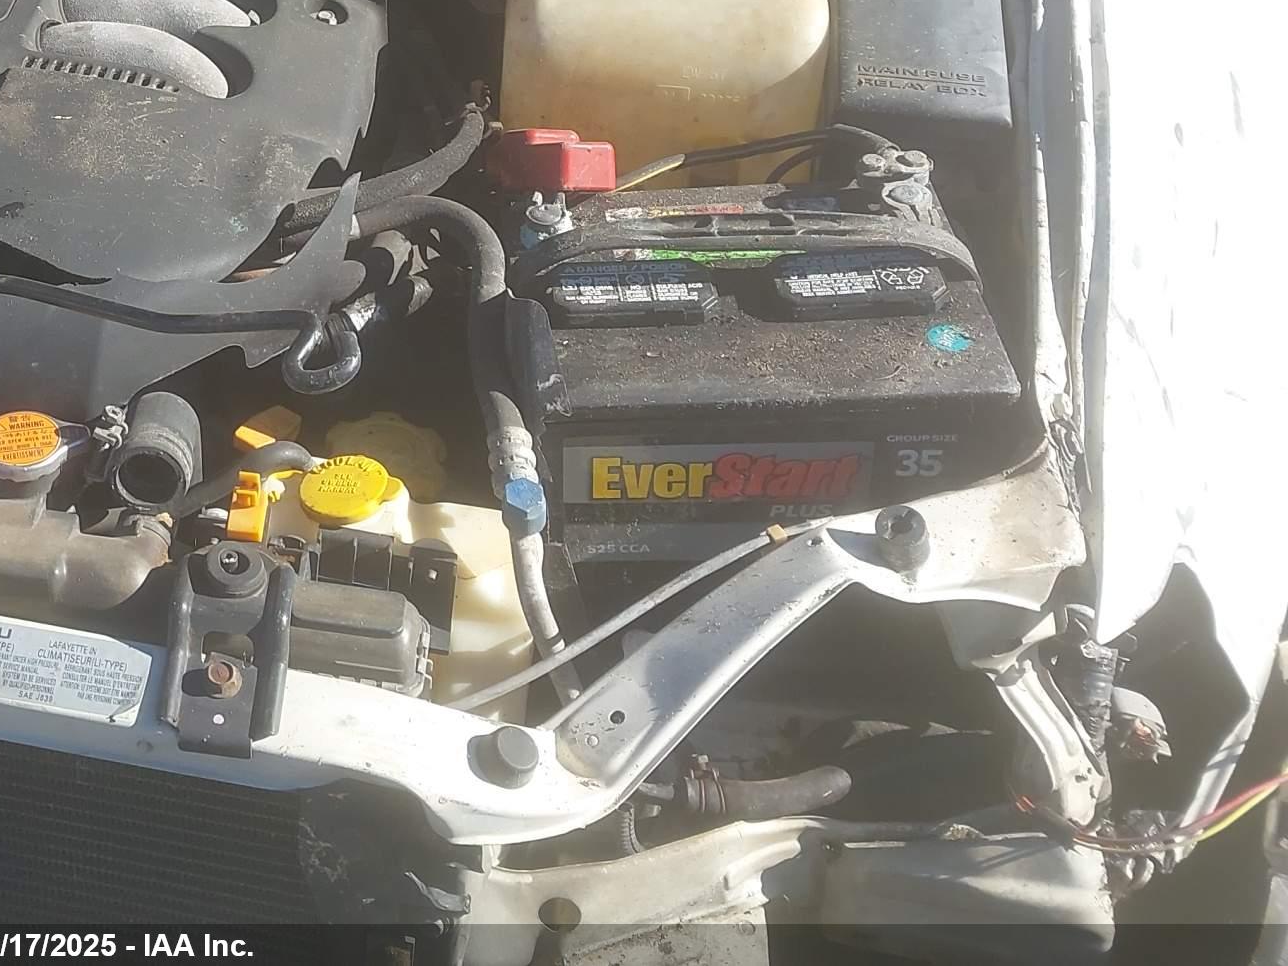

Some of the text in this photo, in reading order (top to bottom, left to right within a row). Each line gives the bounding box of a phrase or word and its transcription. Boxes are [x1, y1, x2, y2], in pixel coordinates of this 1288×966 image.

[857, 64, 986, 83] MAIN FUSE
[857, 77, 988, 98] RELAY BOX
[8, 420, 45, 431] WARNING
[886, 434, 959, 443] GROUP SIZE
[895, 449, 944, 478] 35
[590, 451, 864, 502] EverStart
[769, 503, 833, 519] PLUS
[619, 543, 651, 555] CCA
[48, 640, 89, 655] LAFAYETTE
[18, 690, 33, 700] SAE
